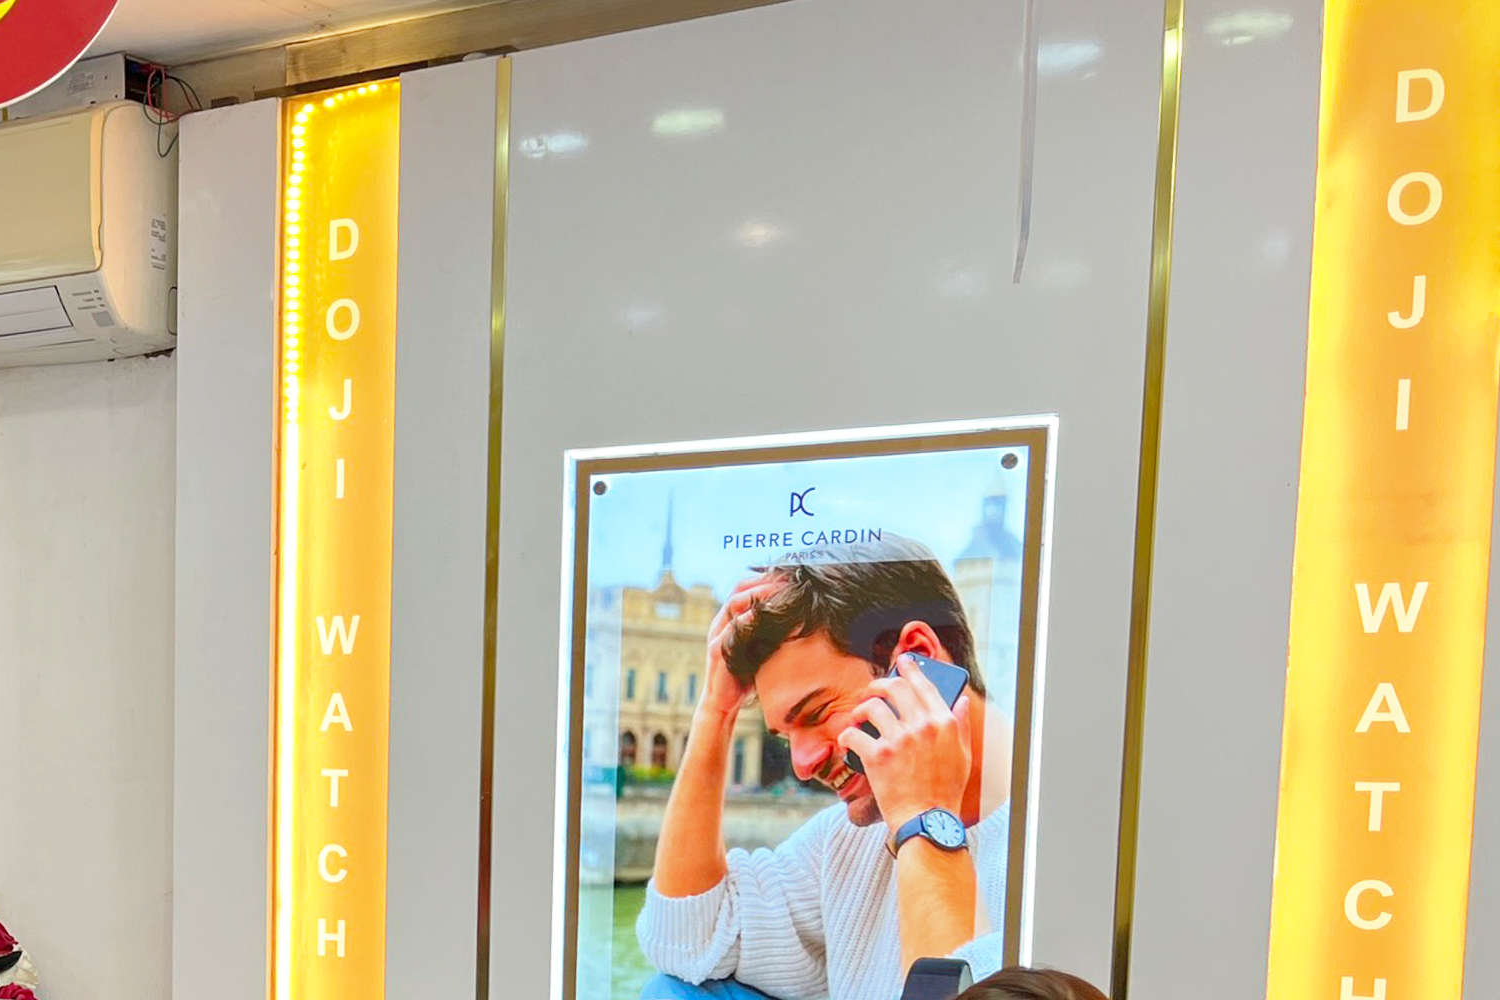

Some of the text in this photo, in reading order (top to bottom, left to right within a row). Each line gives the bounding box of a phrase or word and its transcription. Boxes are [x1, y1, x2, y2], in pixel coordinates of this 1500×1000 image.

[325, 218, 360, 499] DOJI
[1387, 68, 1445, 430] DOJI
[723, 528, 882, 549] PIERRE CARDIN
[785, 550, 816, 560] PARIS
[315, 615, 360, 957] WATCH
